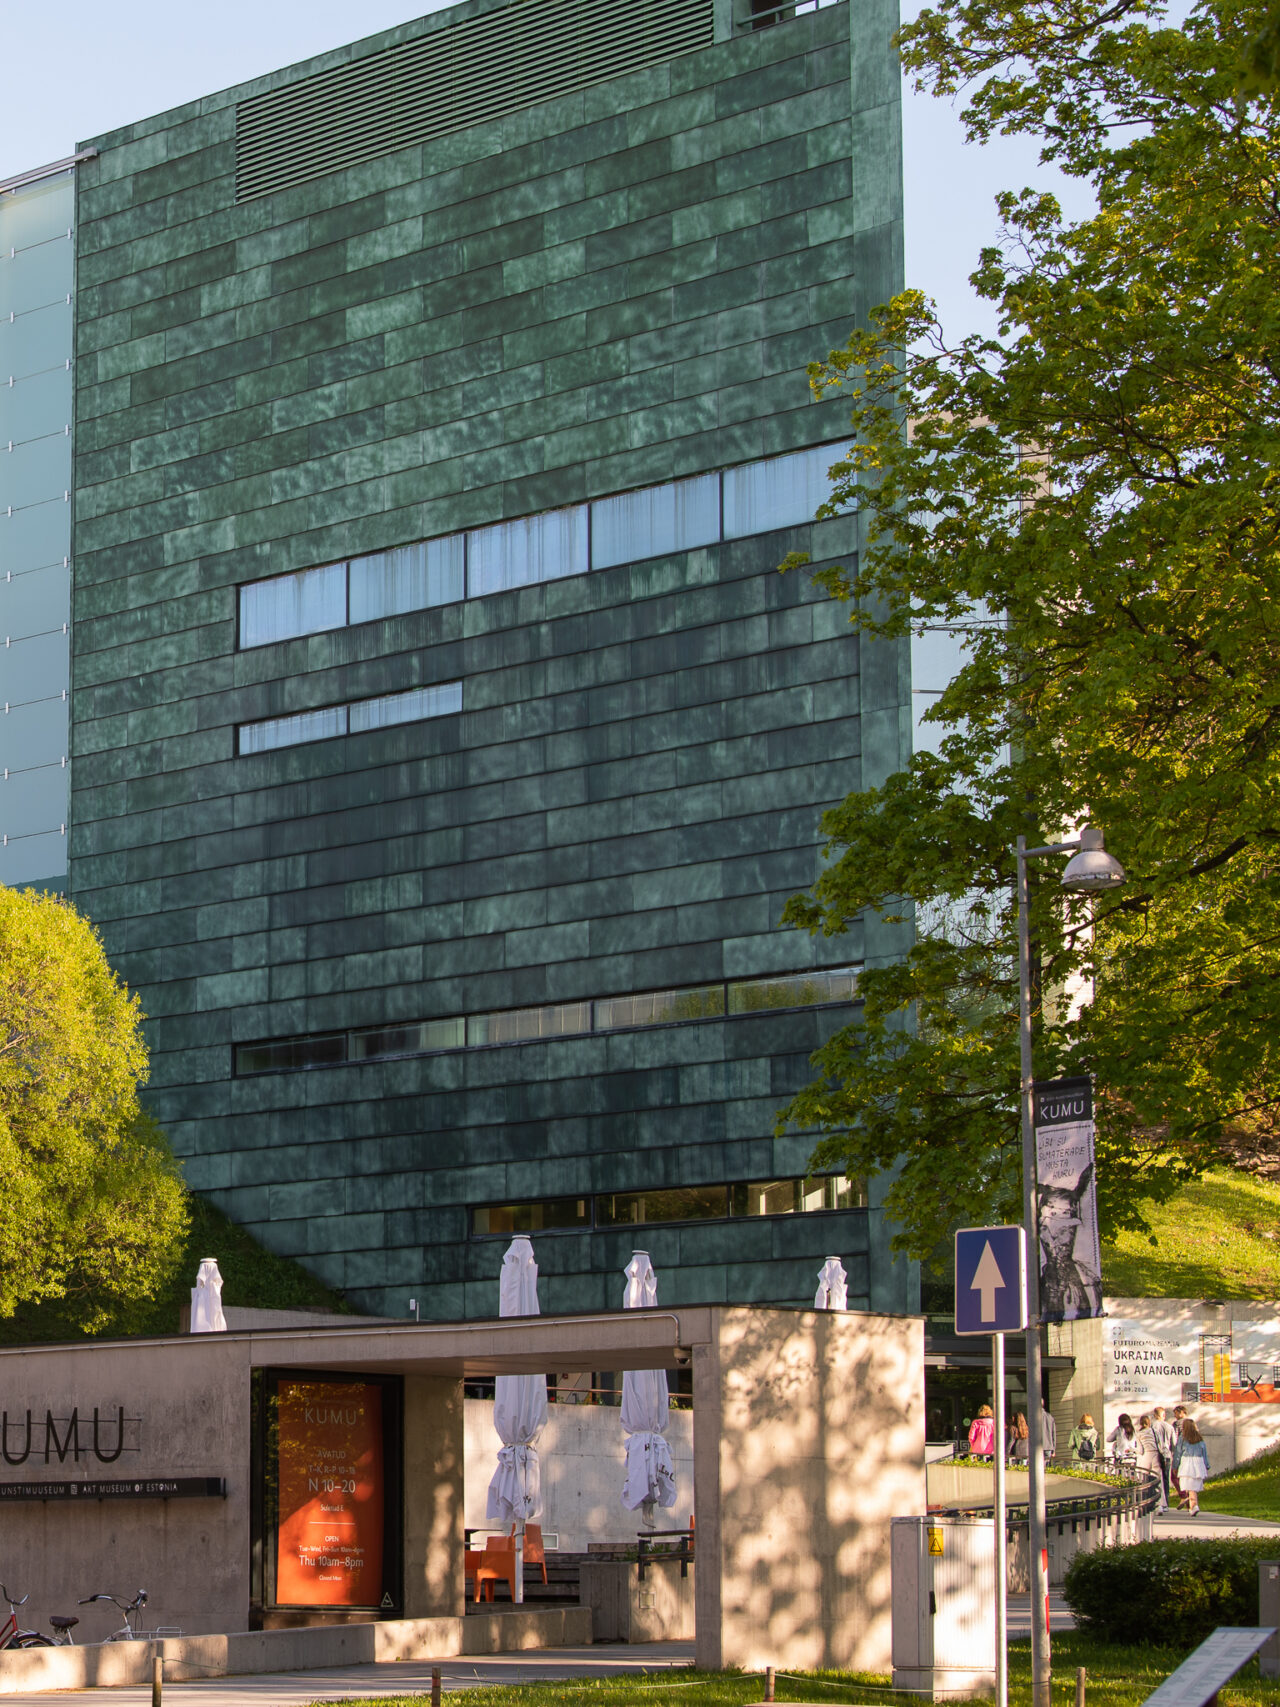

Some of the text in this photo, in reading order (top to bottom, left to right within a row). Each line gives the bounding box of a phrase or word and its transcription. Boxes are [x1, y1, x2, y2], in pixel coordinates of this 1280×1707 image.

[1040, 1101, 1084, 1119] KUMU
[1114, 1351, 1164, 1360] UKRAINA
[1114, 1365, 1192, 1376] JA AVANGARD
[305, 1407, 357, 1425] KUMU
[317, 1450, 346, 1459] AVATUD
[83, 1485, 96, 1493] ART
[100, 1484, 131, 1493] MUSEUM
[134, 1483, 143, 1492] OF
[146, 1482, 178, 1492] ESTONIA
[308, 1478, 356, 1493] N 10–20
[299, 1554, 363, 1570] Thu 10am–8pm
